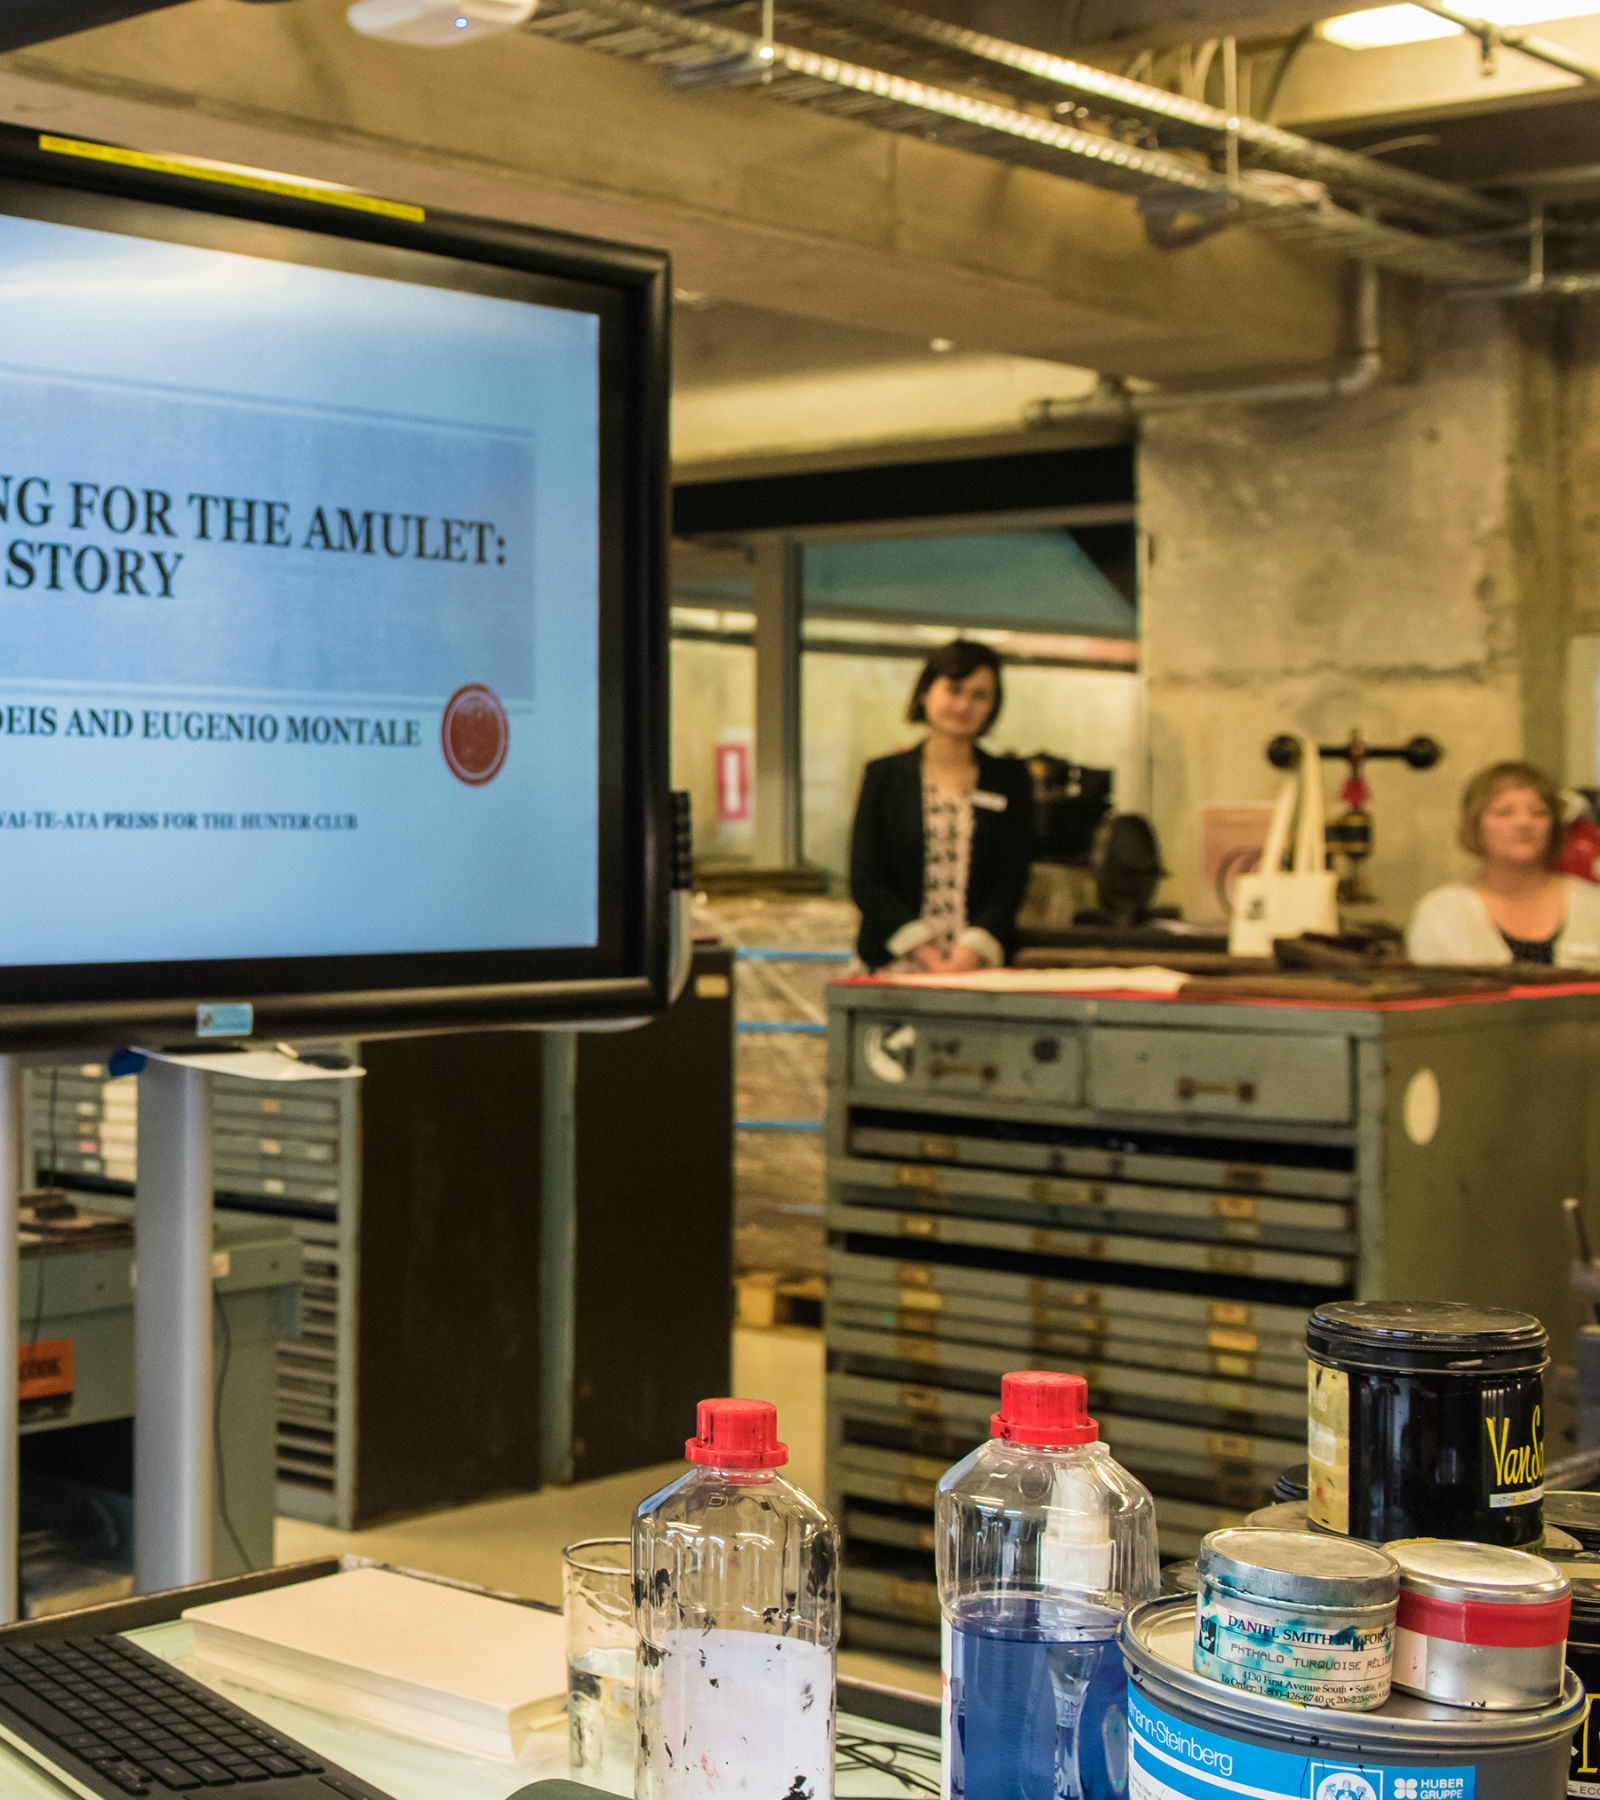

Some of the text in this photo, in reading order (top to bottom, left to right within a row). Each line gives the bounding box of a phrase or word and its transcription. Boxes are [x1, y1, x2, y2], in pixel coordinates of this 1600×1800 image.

[68, 480, 177, 537] FOR
[186, 492, 292, 547] THE
[302, 504, 506, 567] AMULET:
[5, 538, 184, 599] STORY
[64, 707, 134, 738] AND
[140, 709, 280, 744] EUGENIO
[285, 715, 422, 748] MONTALE
[102, 811, 159, 831] PRESS
[162, 811, 200, 831] FOR
[201, 811, 238, 831] THE
[240, 811, 313, 831] HUNTER
[314, 812, 358, 831] CLUB
[1228, 1615, 1279, 1638] DANIEL
[1282, 1628, 1331, 1645] SMITH
[1231, 1643, 1284, 1664] PHTHALO
[1293, 1657, 1362, 1671] TURQUOISE
[1220, 1673, 1230, 1686] To
[1241, 1671, 1262, 1683] 4130
[1263, 1676, 1284, 1688] First
[1285, 1681, 1321, 1693] Avenue
[1322, 1683, 1347, 1693] South
[1129, 1696, 1233, 1776] mann-Steinberg
[1420, 1778, 1464, 1789] HUBER
[1420, 1789, 1463, 1800] GRUPPE
